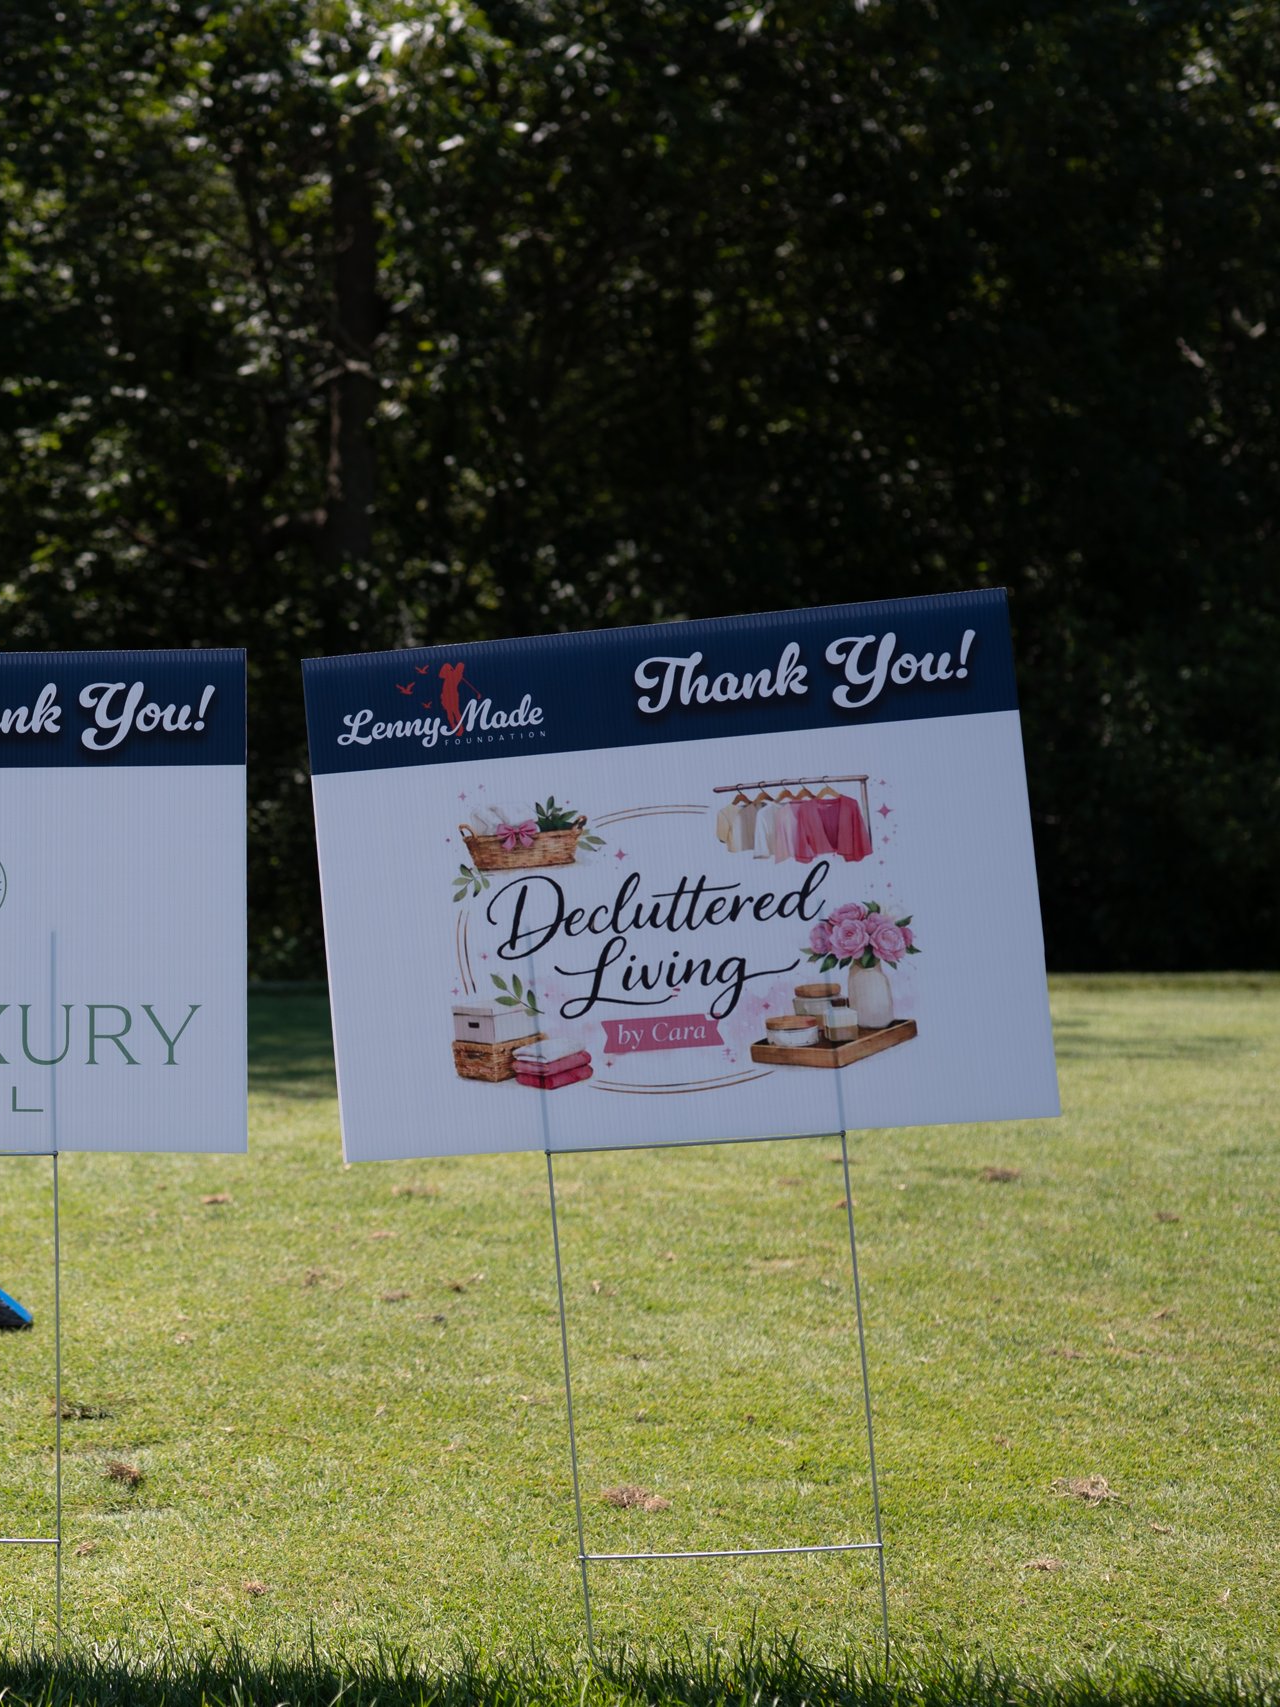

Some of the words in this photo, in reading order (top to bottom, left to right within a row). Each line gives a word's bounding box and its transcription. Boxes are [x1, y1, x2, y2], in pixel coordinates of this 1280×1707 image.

[633, 642, 809, 714] Thank
[825, 629, 977, 709] You!
[79, 681, 216, 751] You!
[337, 709, 441, 747] Lenny
[440, 694, 544, 737] Made
[444, 730, 547, 746] FOUNDATION
[487, 860, 831, 959] Decluttered
[554, 935, 800, 1020] Living
[616, 1024, 646, 1049] by
[652, 1020, 707, 1044] Cara
